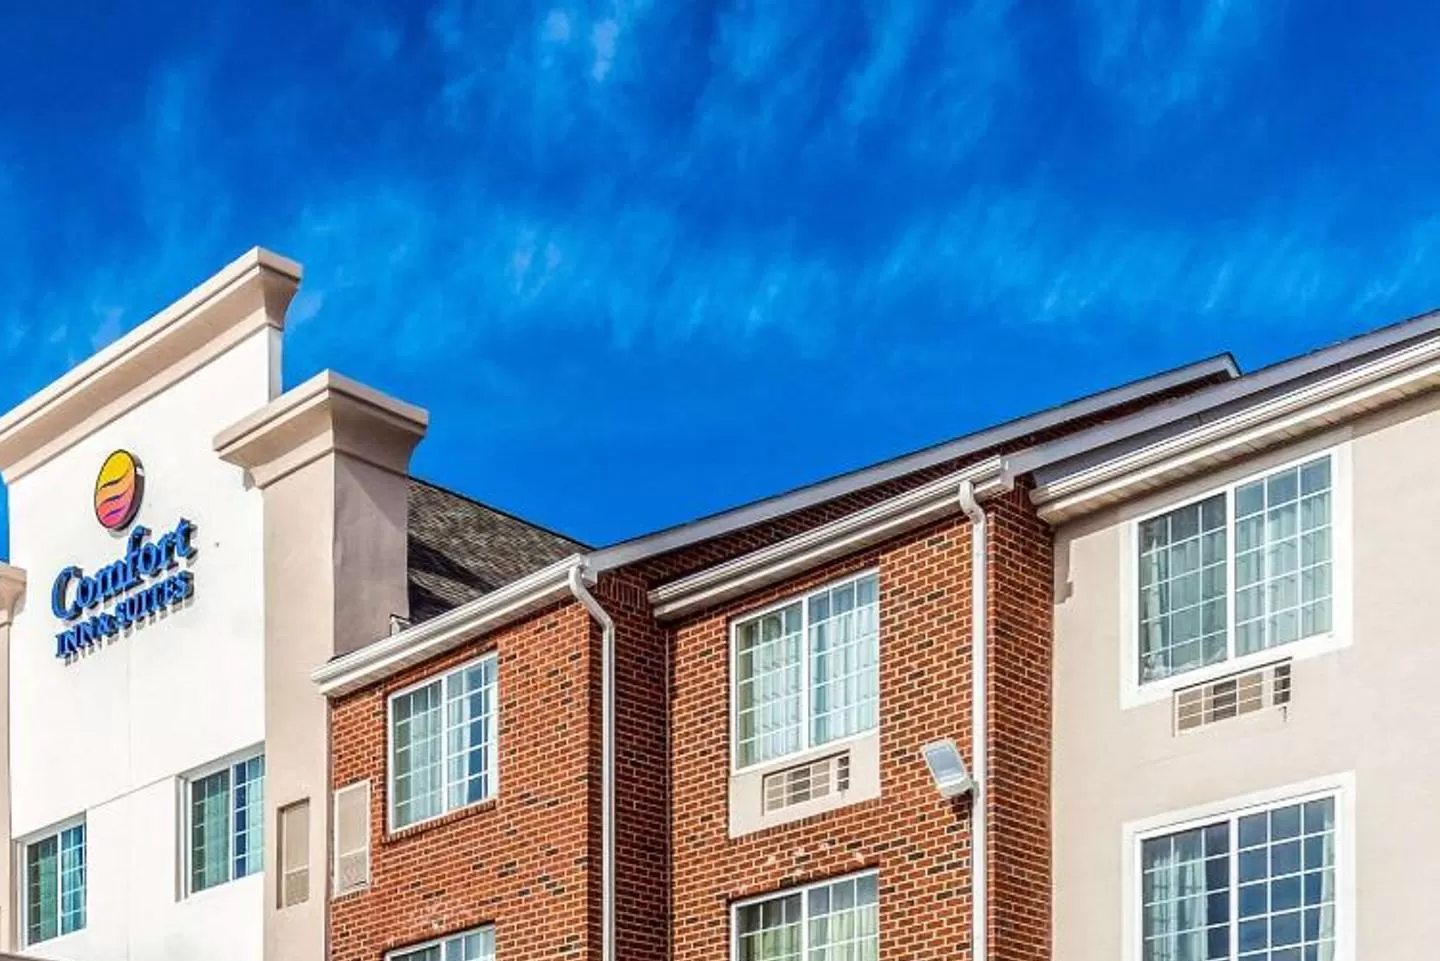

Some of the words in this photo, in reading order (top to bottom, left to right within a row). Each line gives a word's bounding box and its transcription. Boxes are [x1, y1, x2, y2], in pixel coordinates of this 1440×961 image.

[51, 518, 198, 620] Comfort
[55, 616, 102, 658] INN
[115, 570, 194, 629] SUITES
